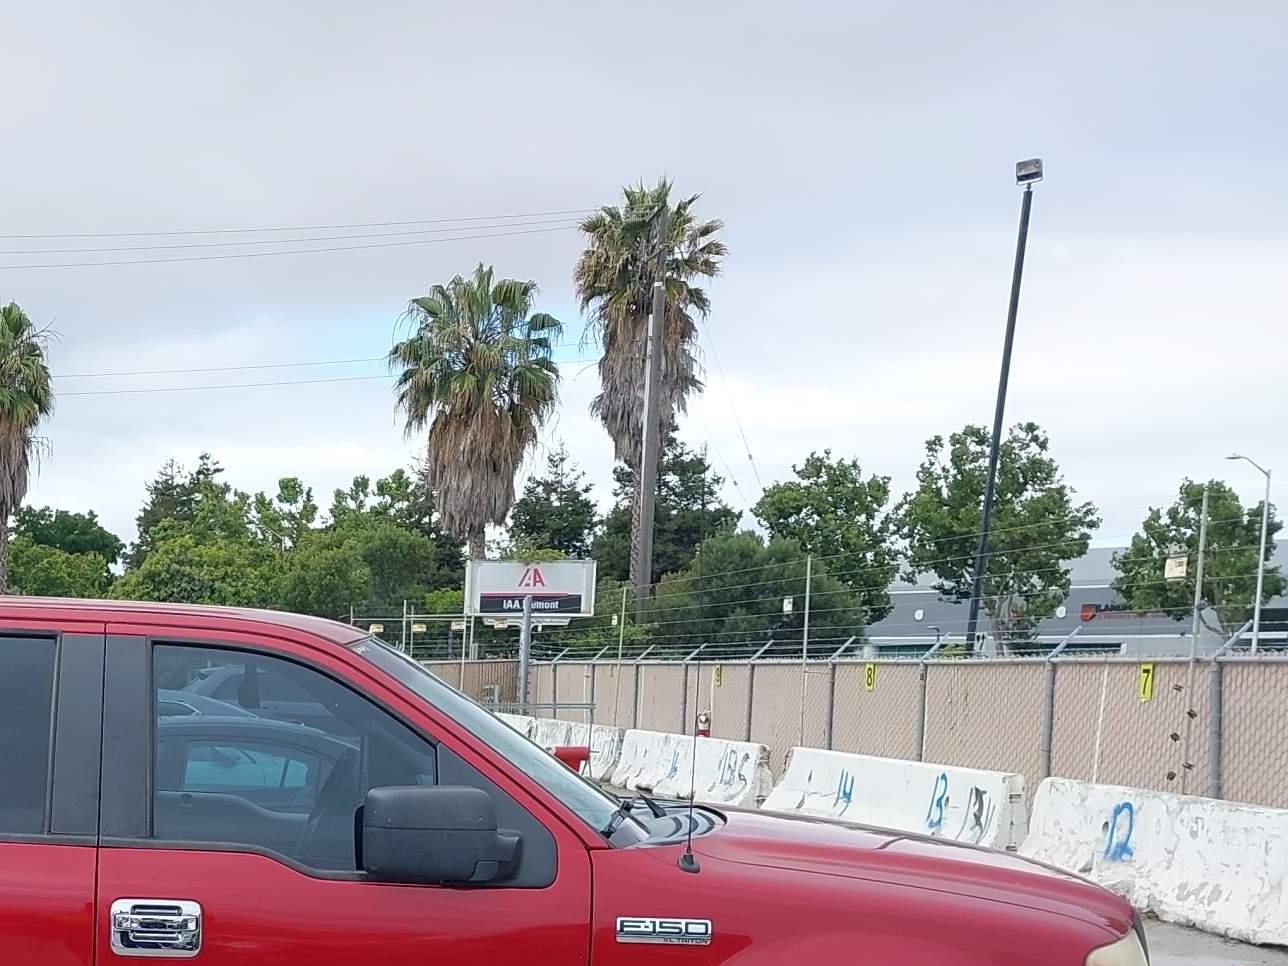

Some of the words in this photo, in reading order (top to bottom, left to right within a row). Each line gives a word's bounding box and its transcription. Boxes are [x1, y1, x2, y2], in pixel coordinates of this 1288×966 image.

[502, 599, 521, 610] IAA
[523, 599, 560, 610] emont
[866, 666, 873, 687] 8
[1141, 668, 1151, 695] 7
[1103, 801, 1134, 862] 12
[619, 919, 709, 935] F-150
